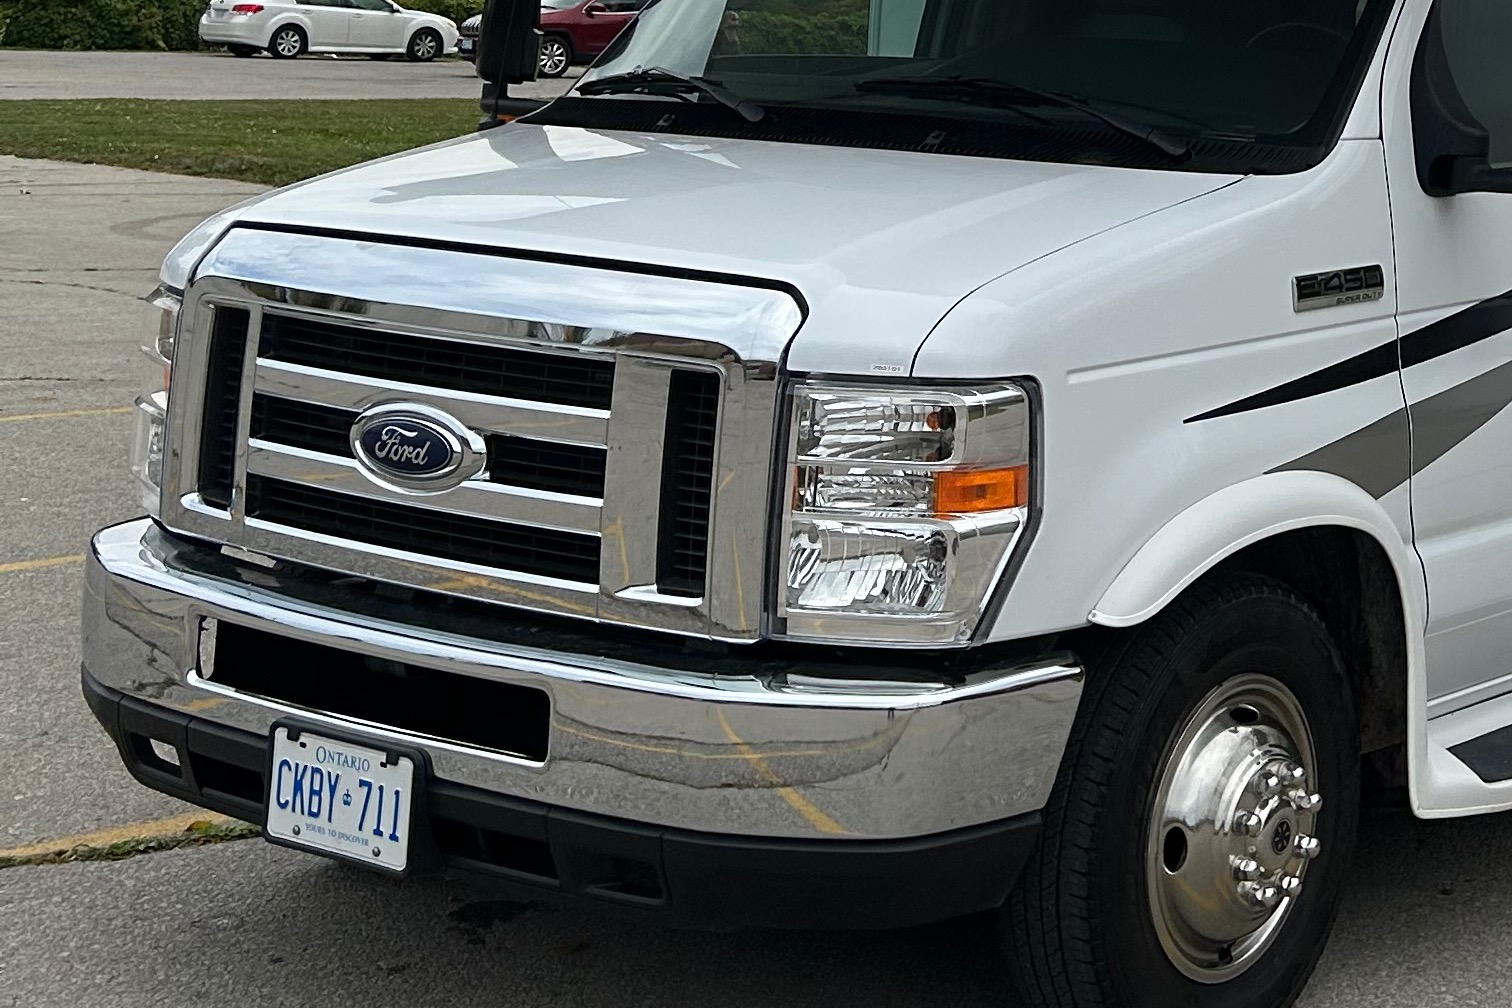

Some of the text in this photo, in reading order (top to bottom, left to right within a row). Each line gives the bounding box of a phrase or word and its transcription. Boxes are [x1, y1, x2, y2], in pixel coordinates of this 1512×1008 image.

[374, 425, 431, 465] Ford
[315, 745, 371, 772] ONTARIO
[276, 758, 401, 843] CKBY 711
